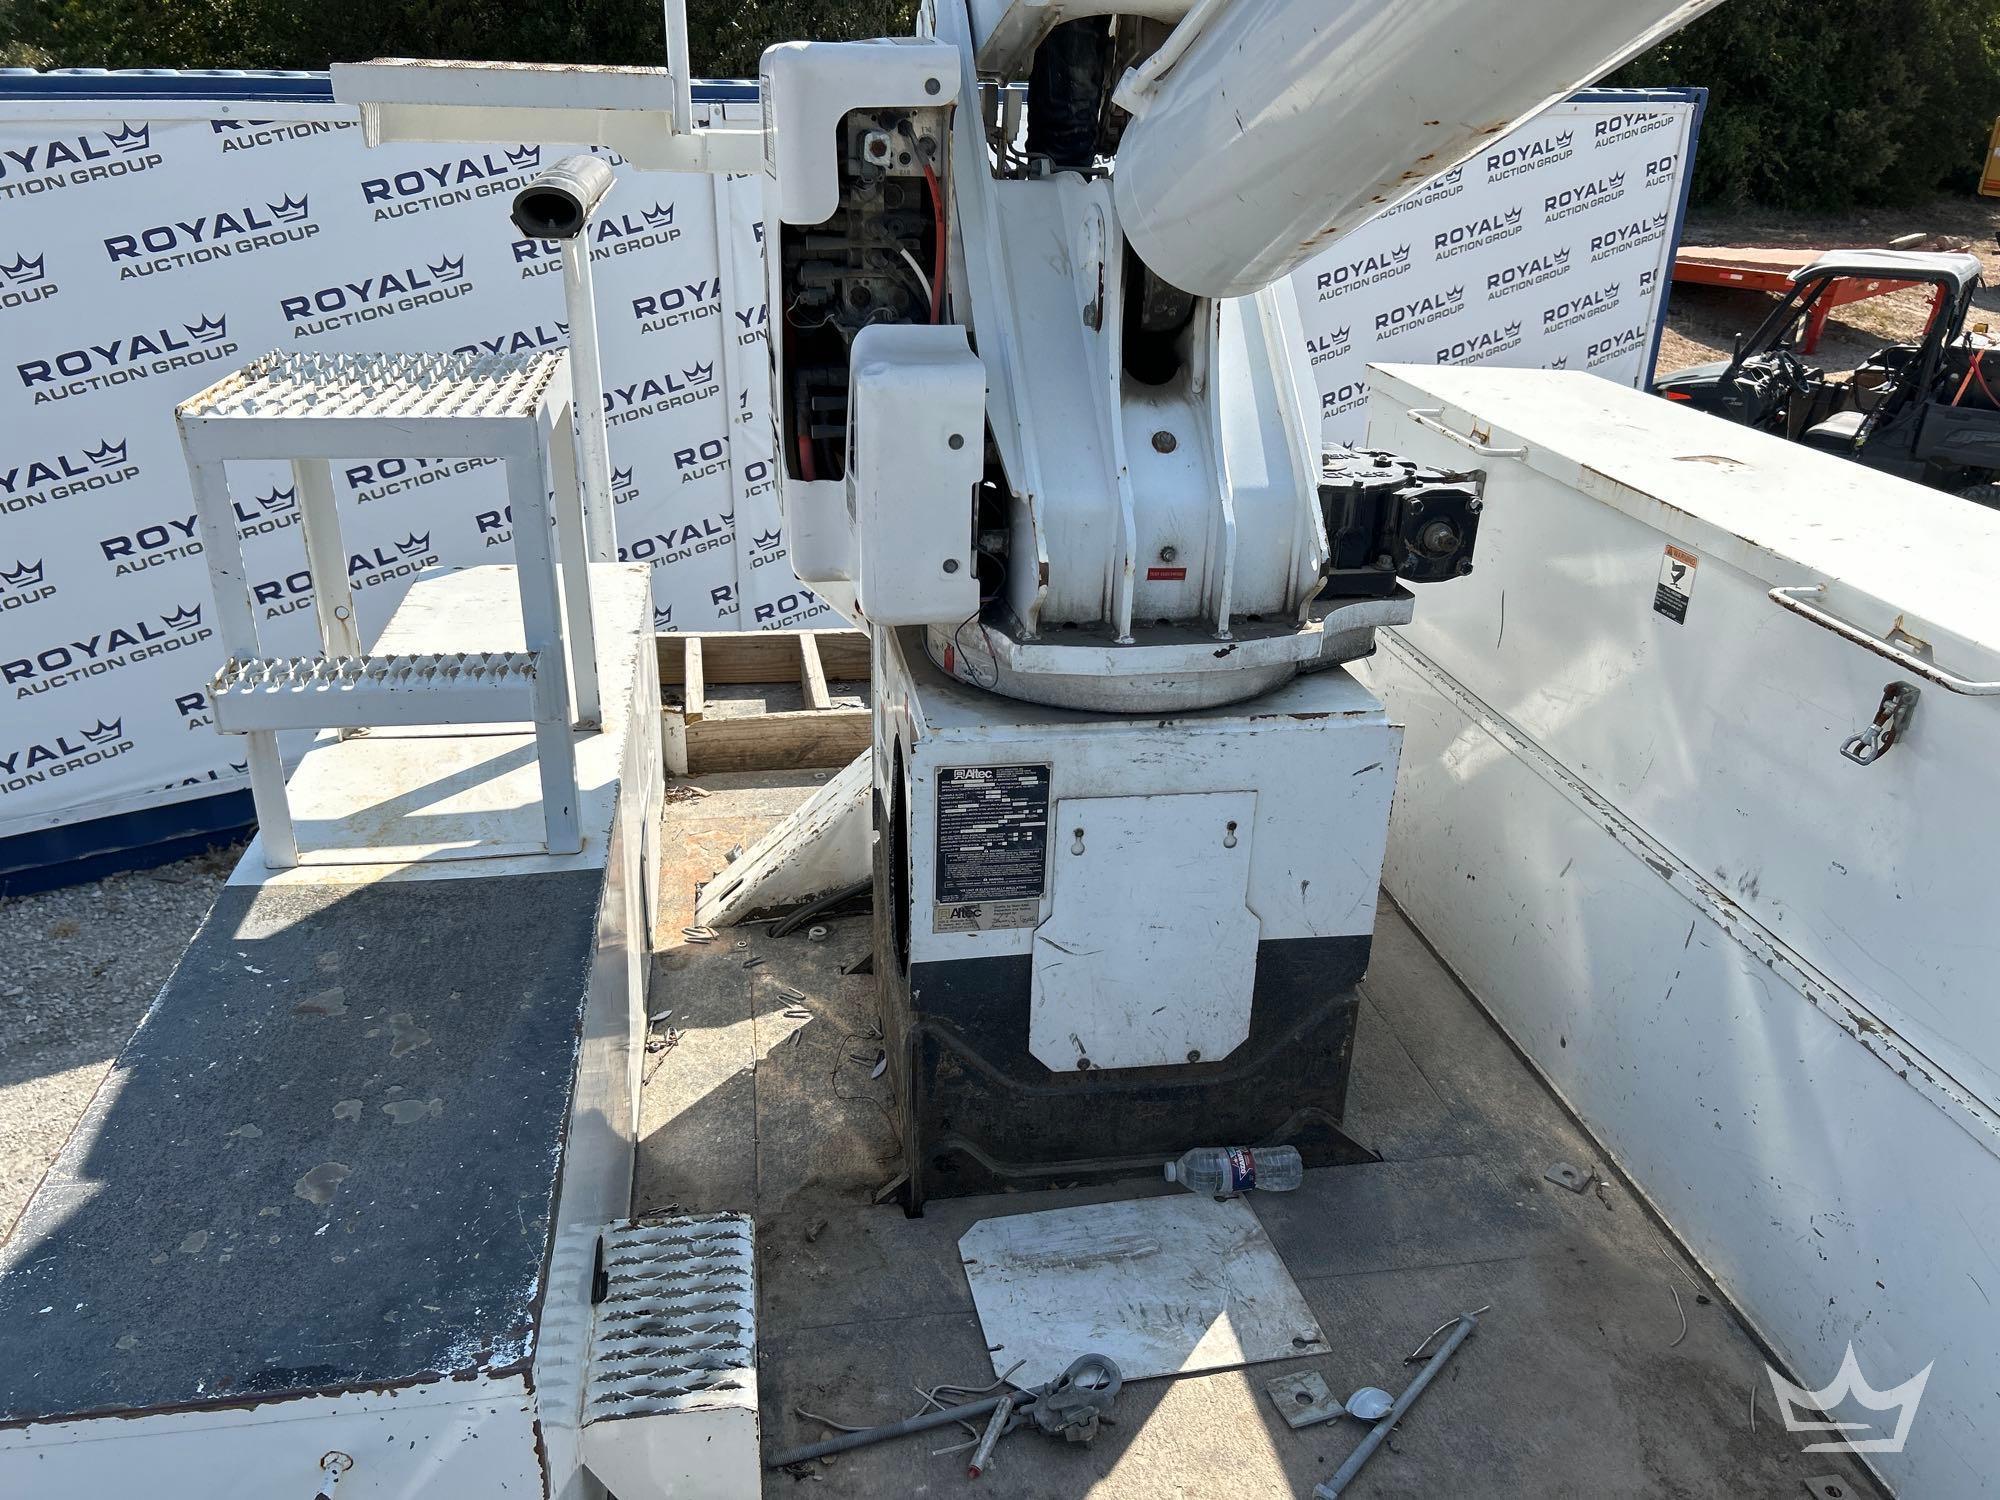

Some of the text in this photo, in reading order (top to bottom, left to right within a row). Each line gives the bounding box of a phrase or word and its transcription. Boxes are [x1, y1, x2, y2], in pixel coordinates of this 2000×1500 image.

[223, 122, 330, 153] AUCTION
[1595, 117, 1673, 149] AUCTION GROUP
[0, 137, 110, 178] YAL
[71, 154, 162, 184] GROUP
[1488, 139, 1555, 172] ROYAL
[1488, 150, 1573, 184] AUCTION GROUP
[361, 155, 507, 204] ROYAL
[1424, 185, 1463, 203] GROUP
[1545, 180, 1607, 212] ROYAL
[374, 172, 542, 222] AUCTION GROU
[1545, 190, 1624, 224] AUCTION GROUP
[104, 208, 272, 262] ROYAL
[614, 228, 681, 255] GROUP
[1435, 215, 1503, 250] ROYAL
[1435, 226, 1522, 262] AUCTION GROUP
[1591, 220, 1651, 252] ROYAL
[120, 224, 320, 281] AUCTION GROUP
[1591, 241, 1632, 263] AUCTION
[1317, 254, 1391, 290] ROYAL
[1319, 264, 1411, 302] AUCTION GROUP
[1487, 256, 1553, 289] ROYAL
[1488, 265, 1570, 301] AUCTION GROUP
[280, 269, 431, 322] ROYAL
[294, 283, 473, 338] AUCTION GROUP
[1375, 294, 1445, 330] ROYAL
[1543, 291, 1603, 324] ROYAL
[641, 303, 722, 334] AUCTION
[1376, 303, 1465, 342] AUCTION GROUP
[1543, 299, 1619, 335] AUCTION GROUP
[17, 329, 189, 387] ROYAL
[1311, 345, 1351, 366] GROUP
[1437, 330, 1504, 364] ROYAL
[1486, 338, 1522, 358] GROUP
[1587, 325, 1645, 359] ROYAL
[1587, 347, 1627, 369] AUCTION
[34, 343, 239, 405] AUCTION GROUP
[657, 385, 720, 411] GROUP
[51, 467, 140, 500] GROUP
[357, 467, 450, 504] AUCTION
[115, 512, 301, 577] AUCTIO ROUP
[367, 555, 438, 587] GROUP
[0, 621, 166, 684] ROYAL
[16, 629, 213, 699] AUCTION GROUP
[49, 741, 134, 776] GROUP
[965, 769, 992, 779] Altec
